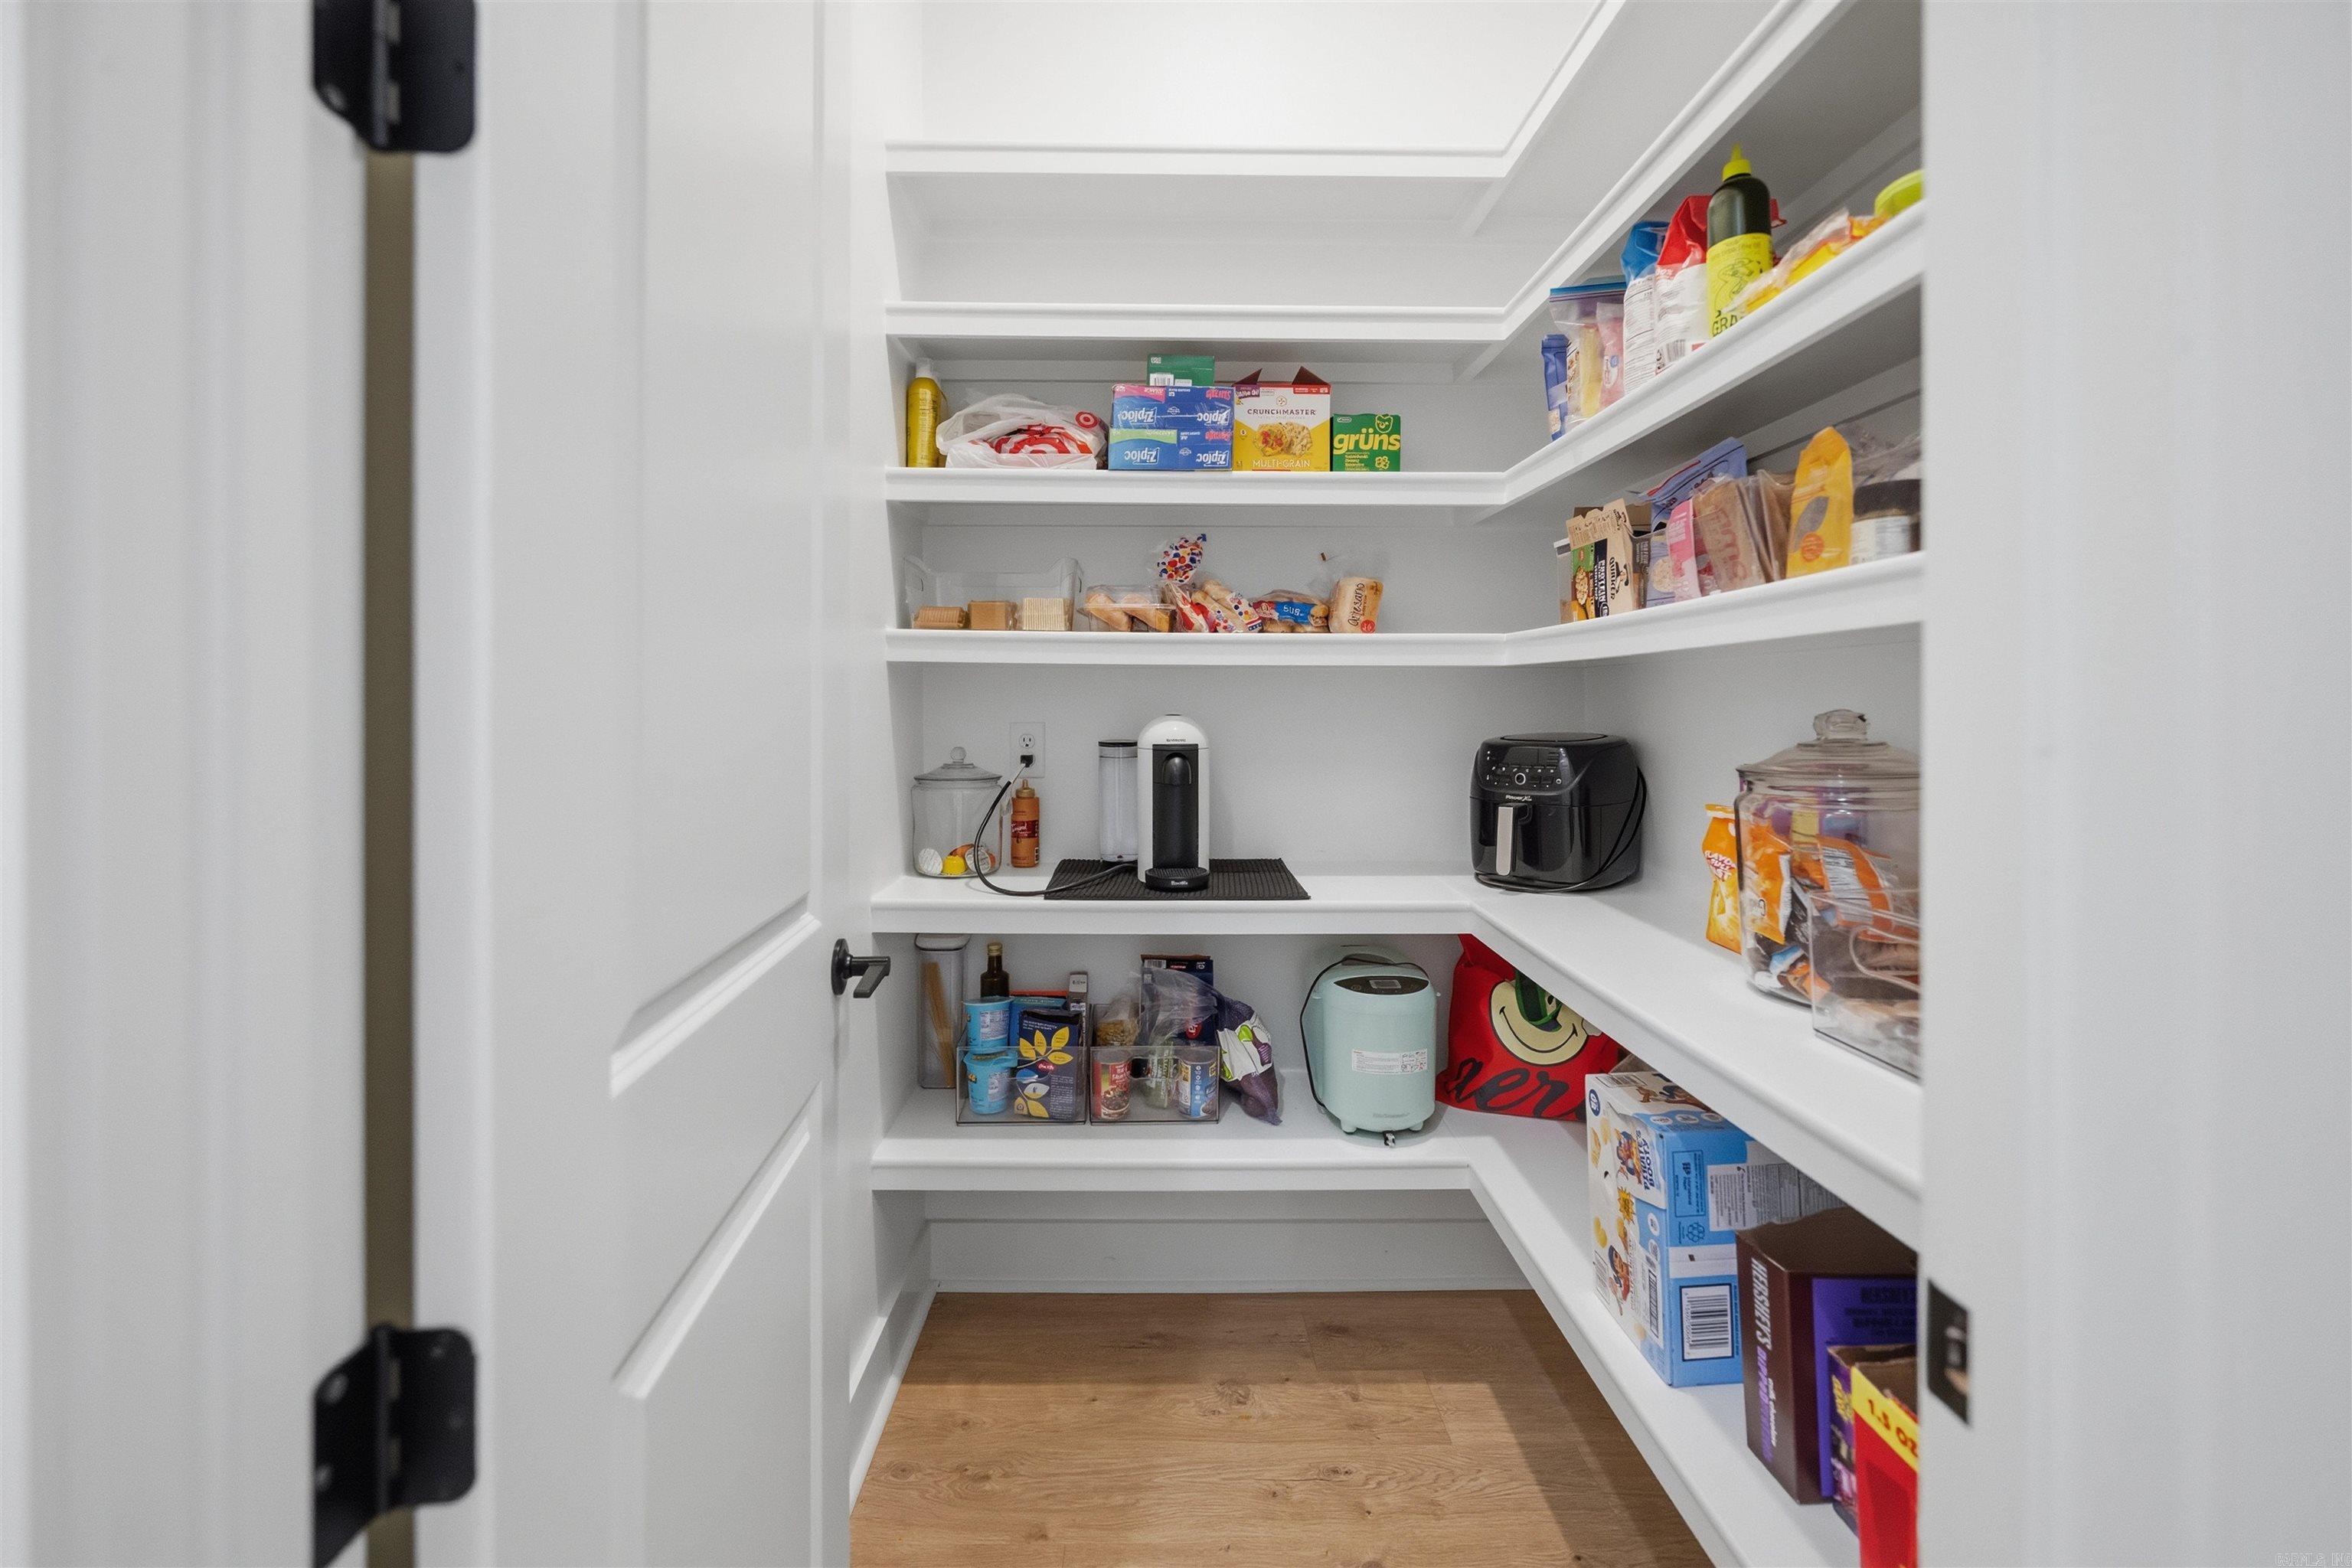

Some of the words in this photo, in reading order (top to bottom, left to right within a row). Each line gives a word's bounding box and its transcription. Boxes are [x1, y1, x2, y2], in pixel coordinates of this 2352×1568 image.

[1712, 314, 1743, 337] GRA
[1120, 407, 1155, 423] Ziploc
[1196, 410, 1228, 425] Ziploc
[1334, 427, 1401, 455] grüns
[1124, 447, 1158, 462] Ziploc
[1196, 450, 1227, 466] Ziploc
[1642, 1138, 1655, 1187] BOOTY
[1751, 1257, 1772, 1351] HERSHEY'S
